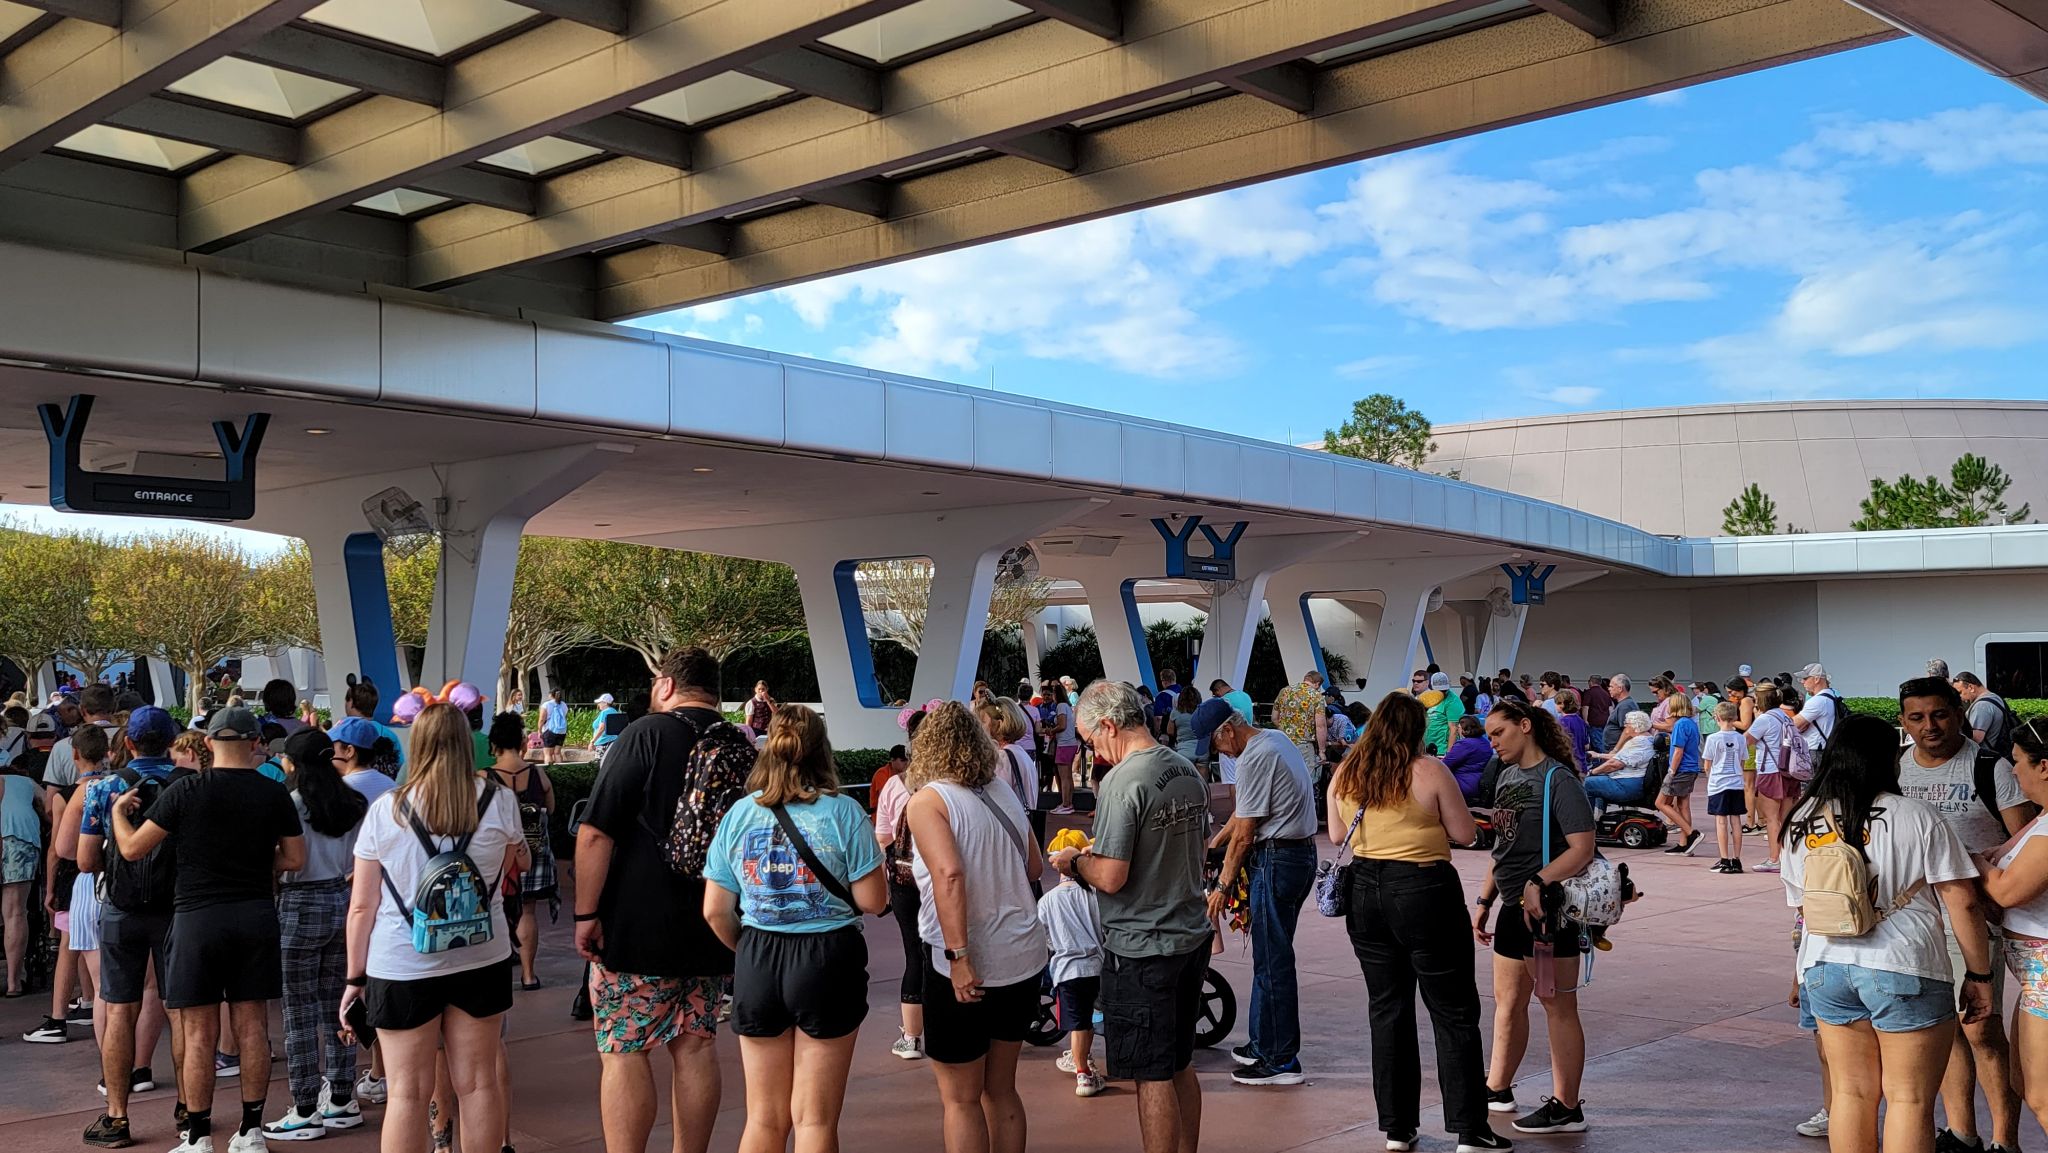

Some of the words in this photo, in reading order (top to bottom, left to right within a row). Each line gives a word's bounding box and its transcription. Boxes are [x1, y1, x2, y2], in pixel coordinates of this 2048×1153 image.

[134, 490, 193, 503] ENTRANCE
[1927, 791, 1948, 801] DEPT
[1931, 783, 1948, 792] EST.
[1947, 783, 1970, 801] 78
[762, 860, 794, 875] Jeep
